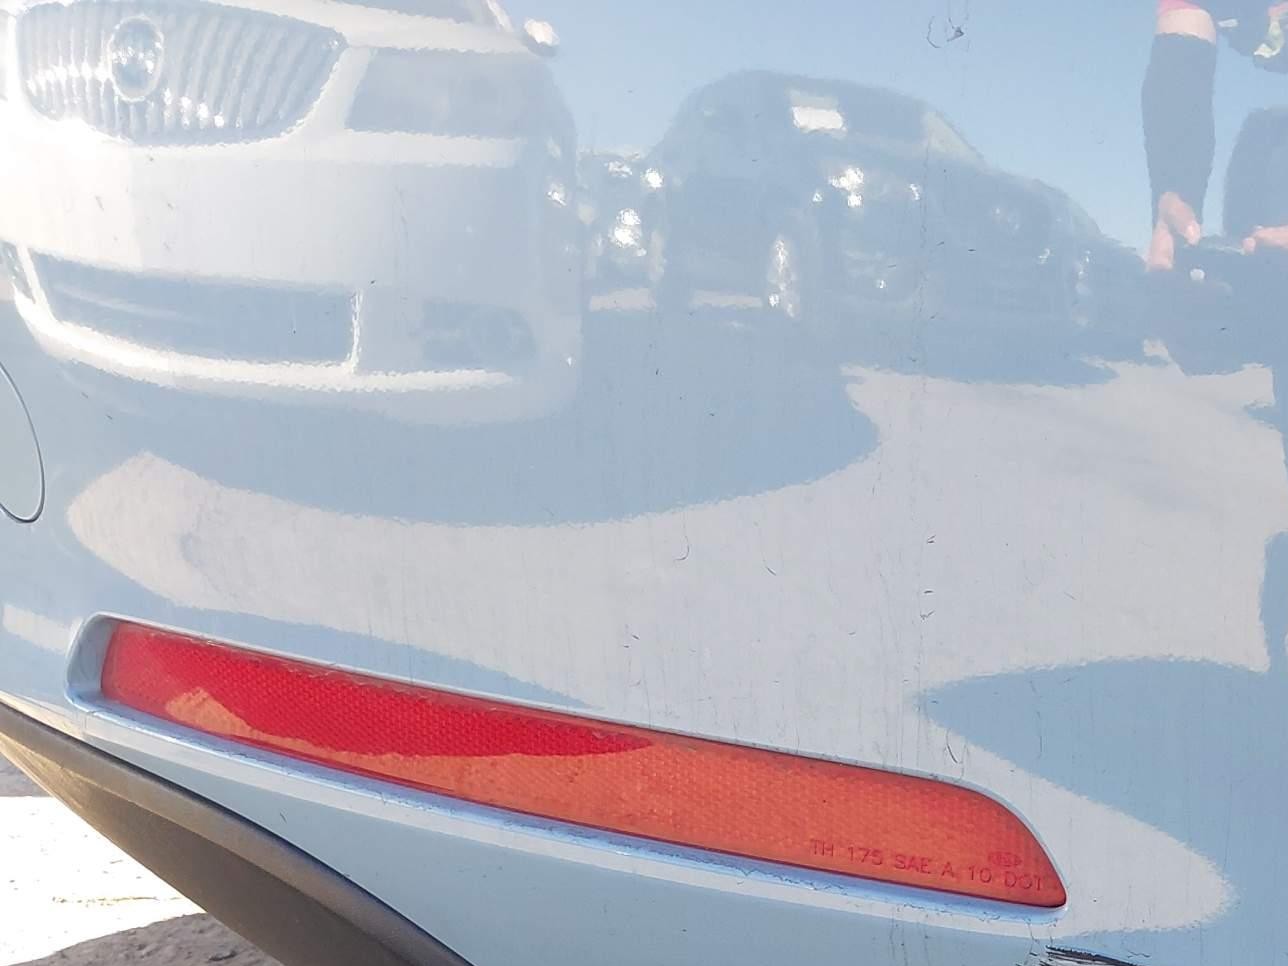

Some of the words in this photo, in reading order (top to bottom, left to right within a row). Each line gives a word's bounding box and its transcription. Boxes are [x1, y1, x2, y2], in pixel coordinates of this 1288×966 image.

[810, 838, 834, 857] TH
[848, 845, 883, 866] 175
[894, 853, 932, 875] SAE
[941, 861, 955, 878] A
[1004, 871, 1042, 891] DOT
